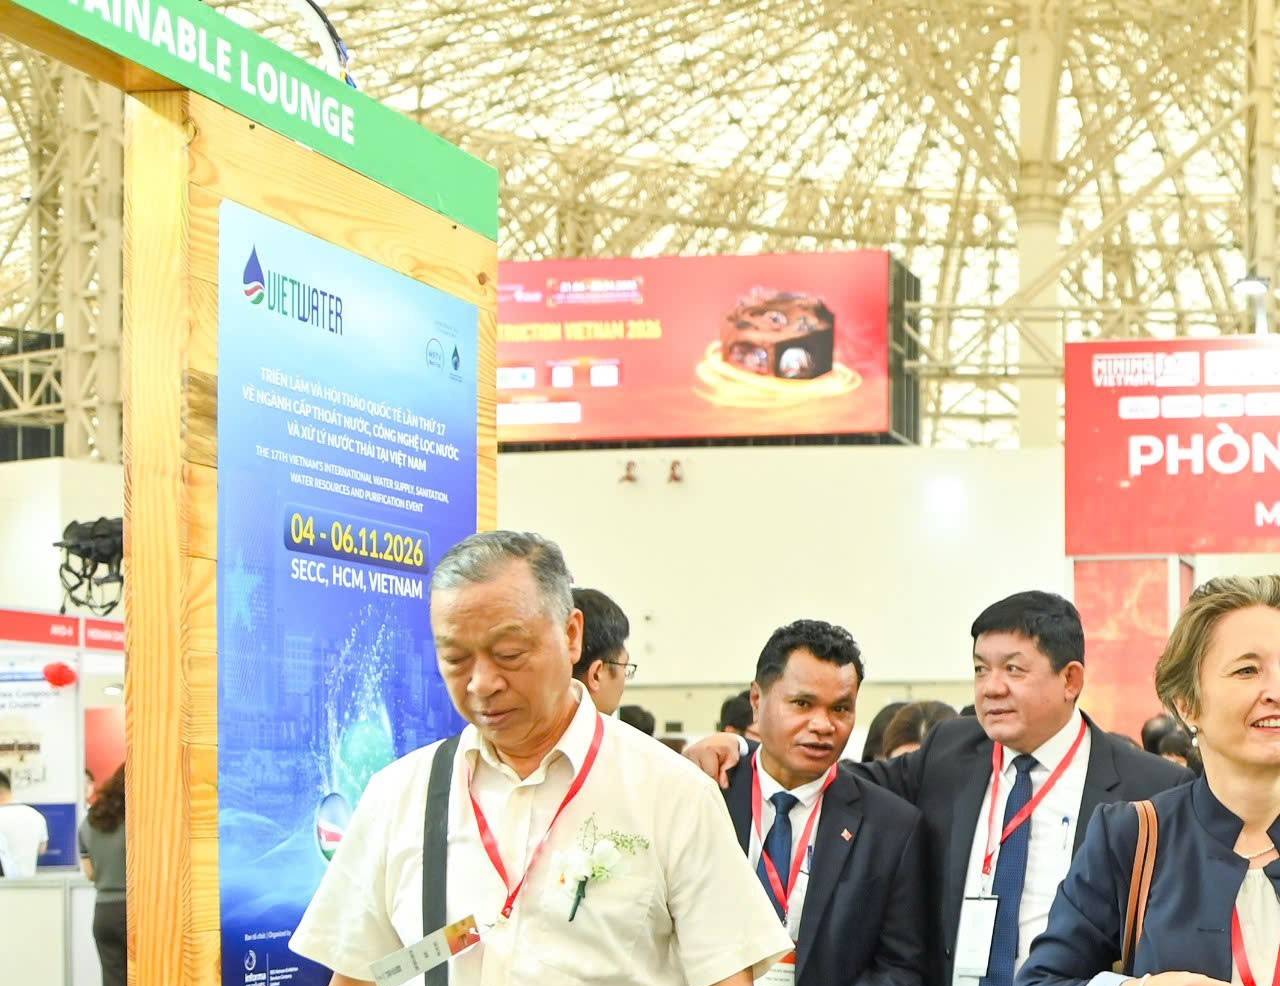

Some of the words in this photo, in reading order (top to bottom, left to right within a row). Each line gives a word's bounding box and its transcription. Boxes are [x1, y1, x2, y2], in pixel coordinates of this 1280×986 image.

[239, 49, 355, 145] LOUNGE
[256, 444, 270, 459] THE
[270, 448, 289, 463] 17TH
[372, 474, 395, 490] WATER
[406, 455, 428, 472] NAM
[289, 471, 315, 489] WATER
[313, 478, 351, 497] RESOURCES
[350, 485, 365, 500] AND
[364, 489, 407, 510] PURIFICATION
[405, 499, 425, 513] EVENT
[290, 511, 316, 547] 04
[319, 530, 328, 541] -
[330, 520, 425, 567] 06.11.2026
[290, 556, 330, 588] SECC,
[332, 564, 368, 593] HCM,
[367, 570, 424, 600] VIETNAM
